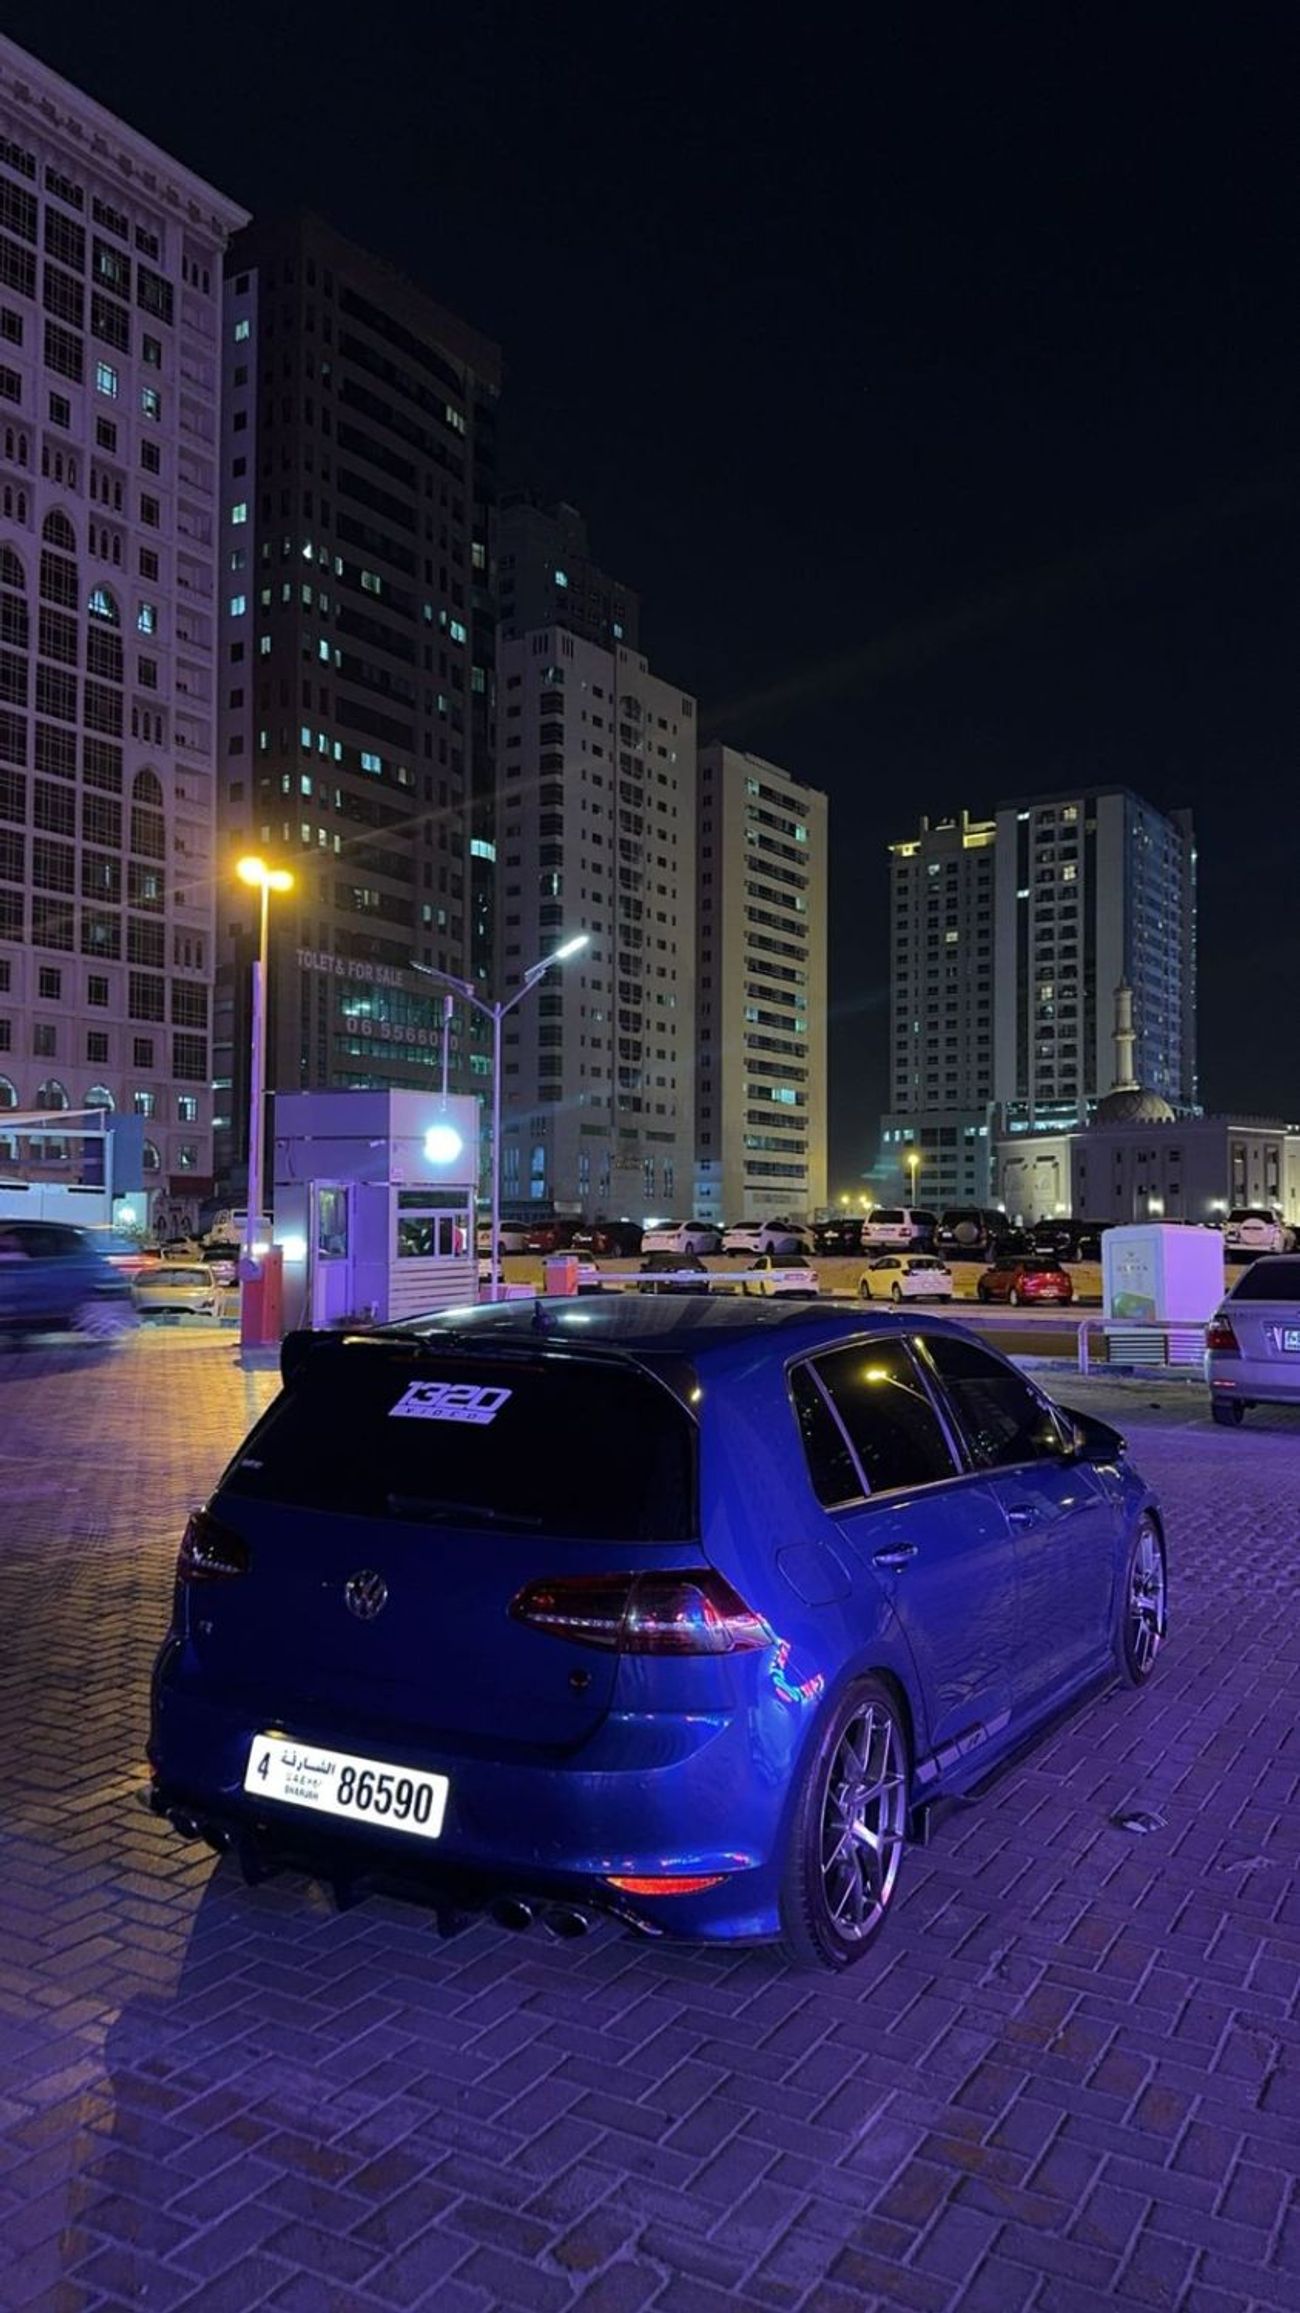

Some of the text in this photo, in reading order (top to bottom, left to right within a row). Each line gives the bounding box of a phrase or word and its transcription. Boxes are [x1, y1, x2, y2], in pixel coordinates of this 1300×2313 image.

[348, 960, 373, 981] FOR
[375, 966, 404, 987] SALE
[346, 1017, 458, 1050] 06 556600
[398, 1381, 512, 1412] 1320
[257, 1752, 270, 1781] 4
[337, 1766, 433, 1824] 86590
